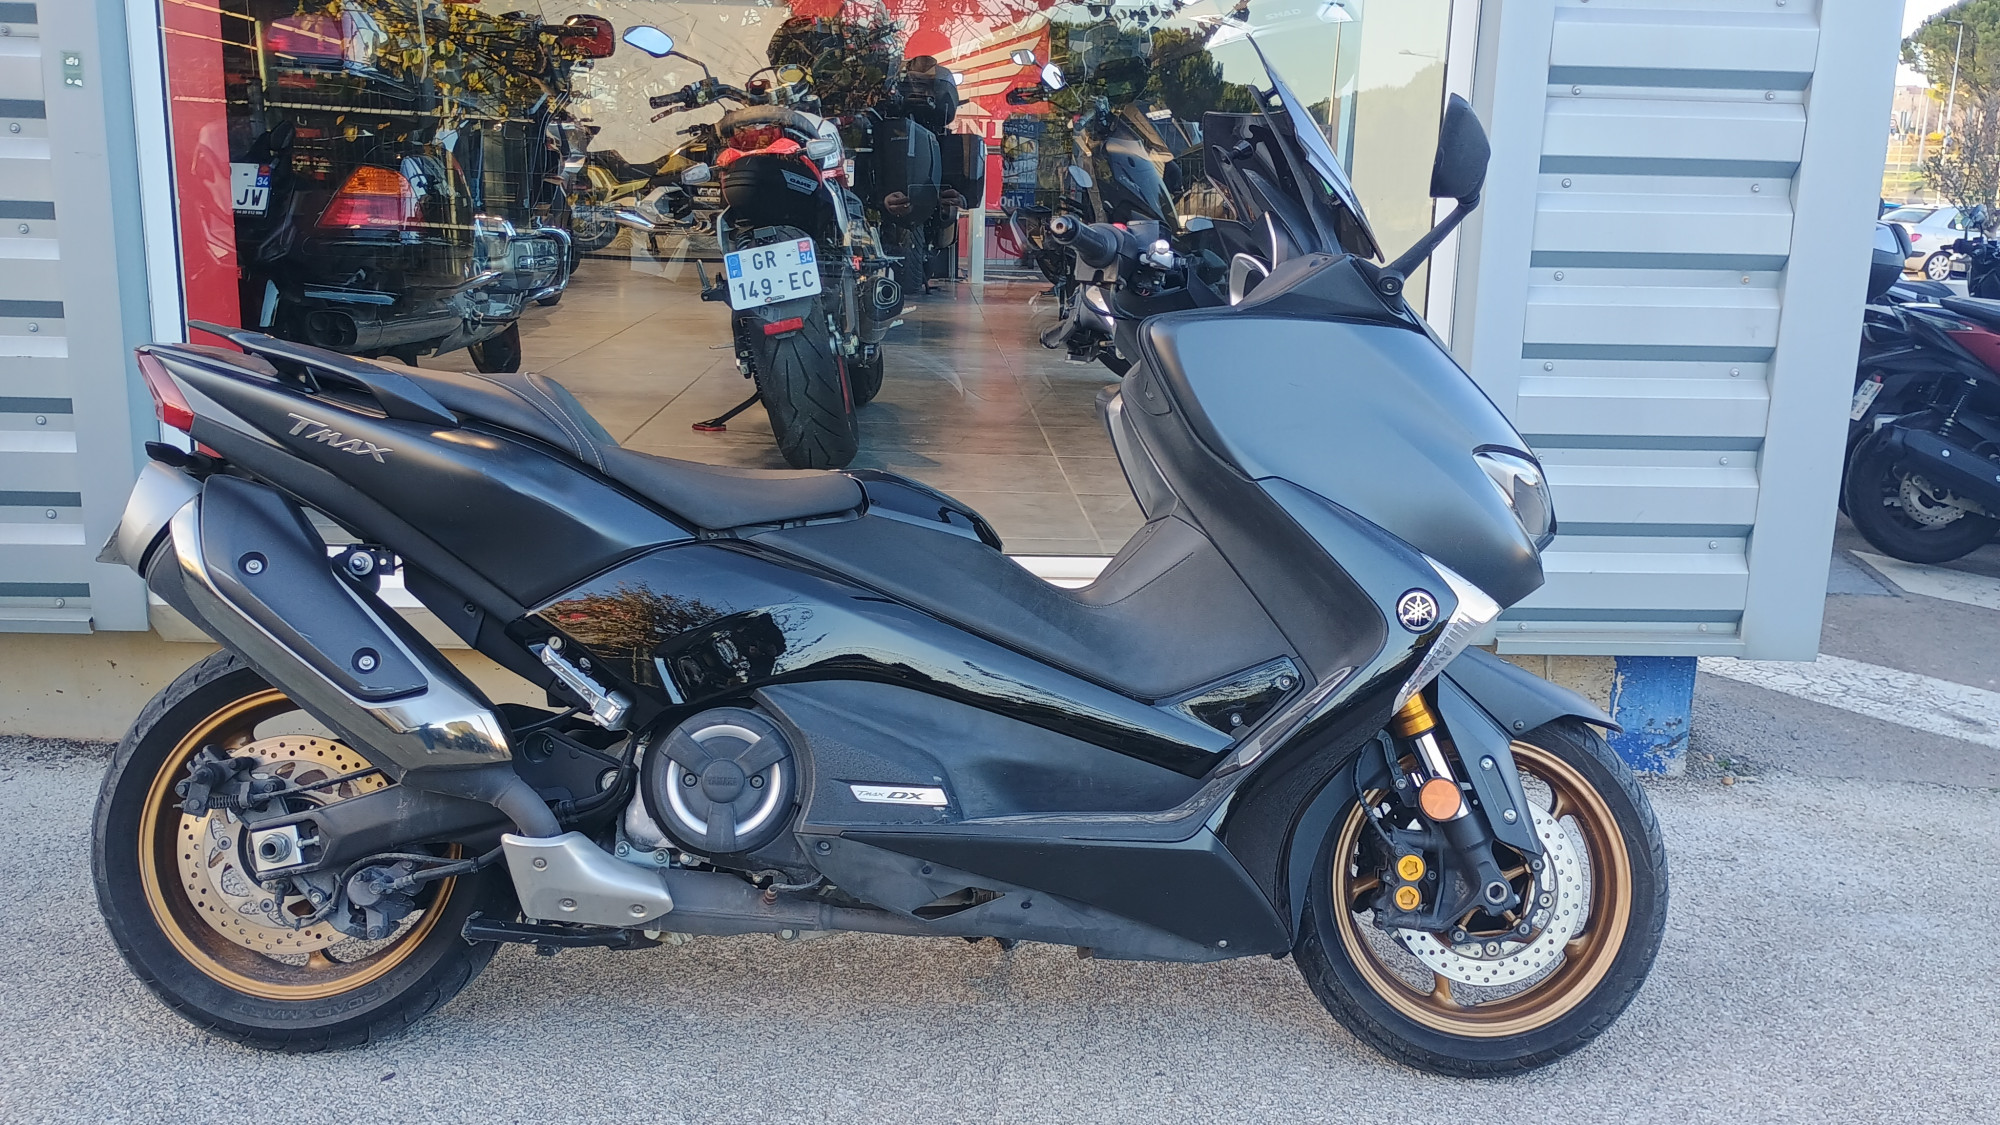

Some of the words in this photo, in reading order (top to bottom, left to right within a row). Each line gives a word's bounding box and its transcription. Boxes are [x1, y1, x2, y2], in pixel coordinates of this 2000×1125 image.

[256, 177, 269, 186] 34
[236, 189, 263, 206] JW
[752, 250, 777, 270] GR
[800, 251, 813, 264] 34
[288, 412, 394, 464] TMAX
[886, 791, 925, 800] DX
